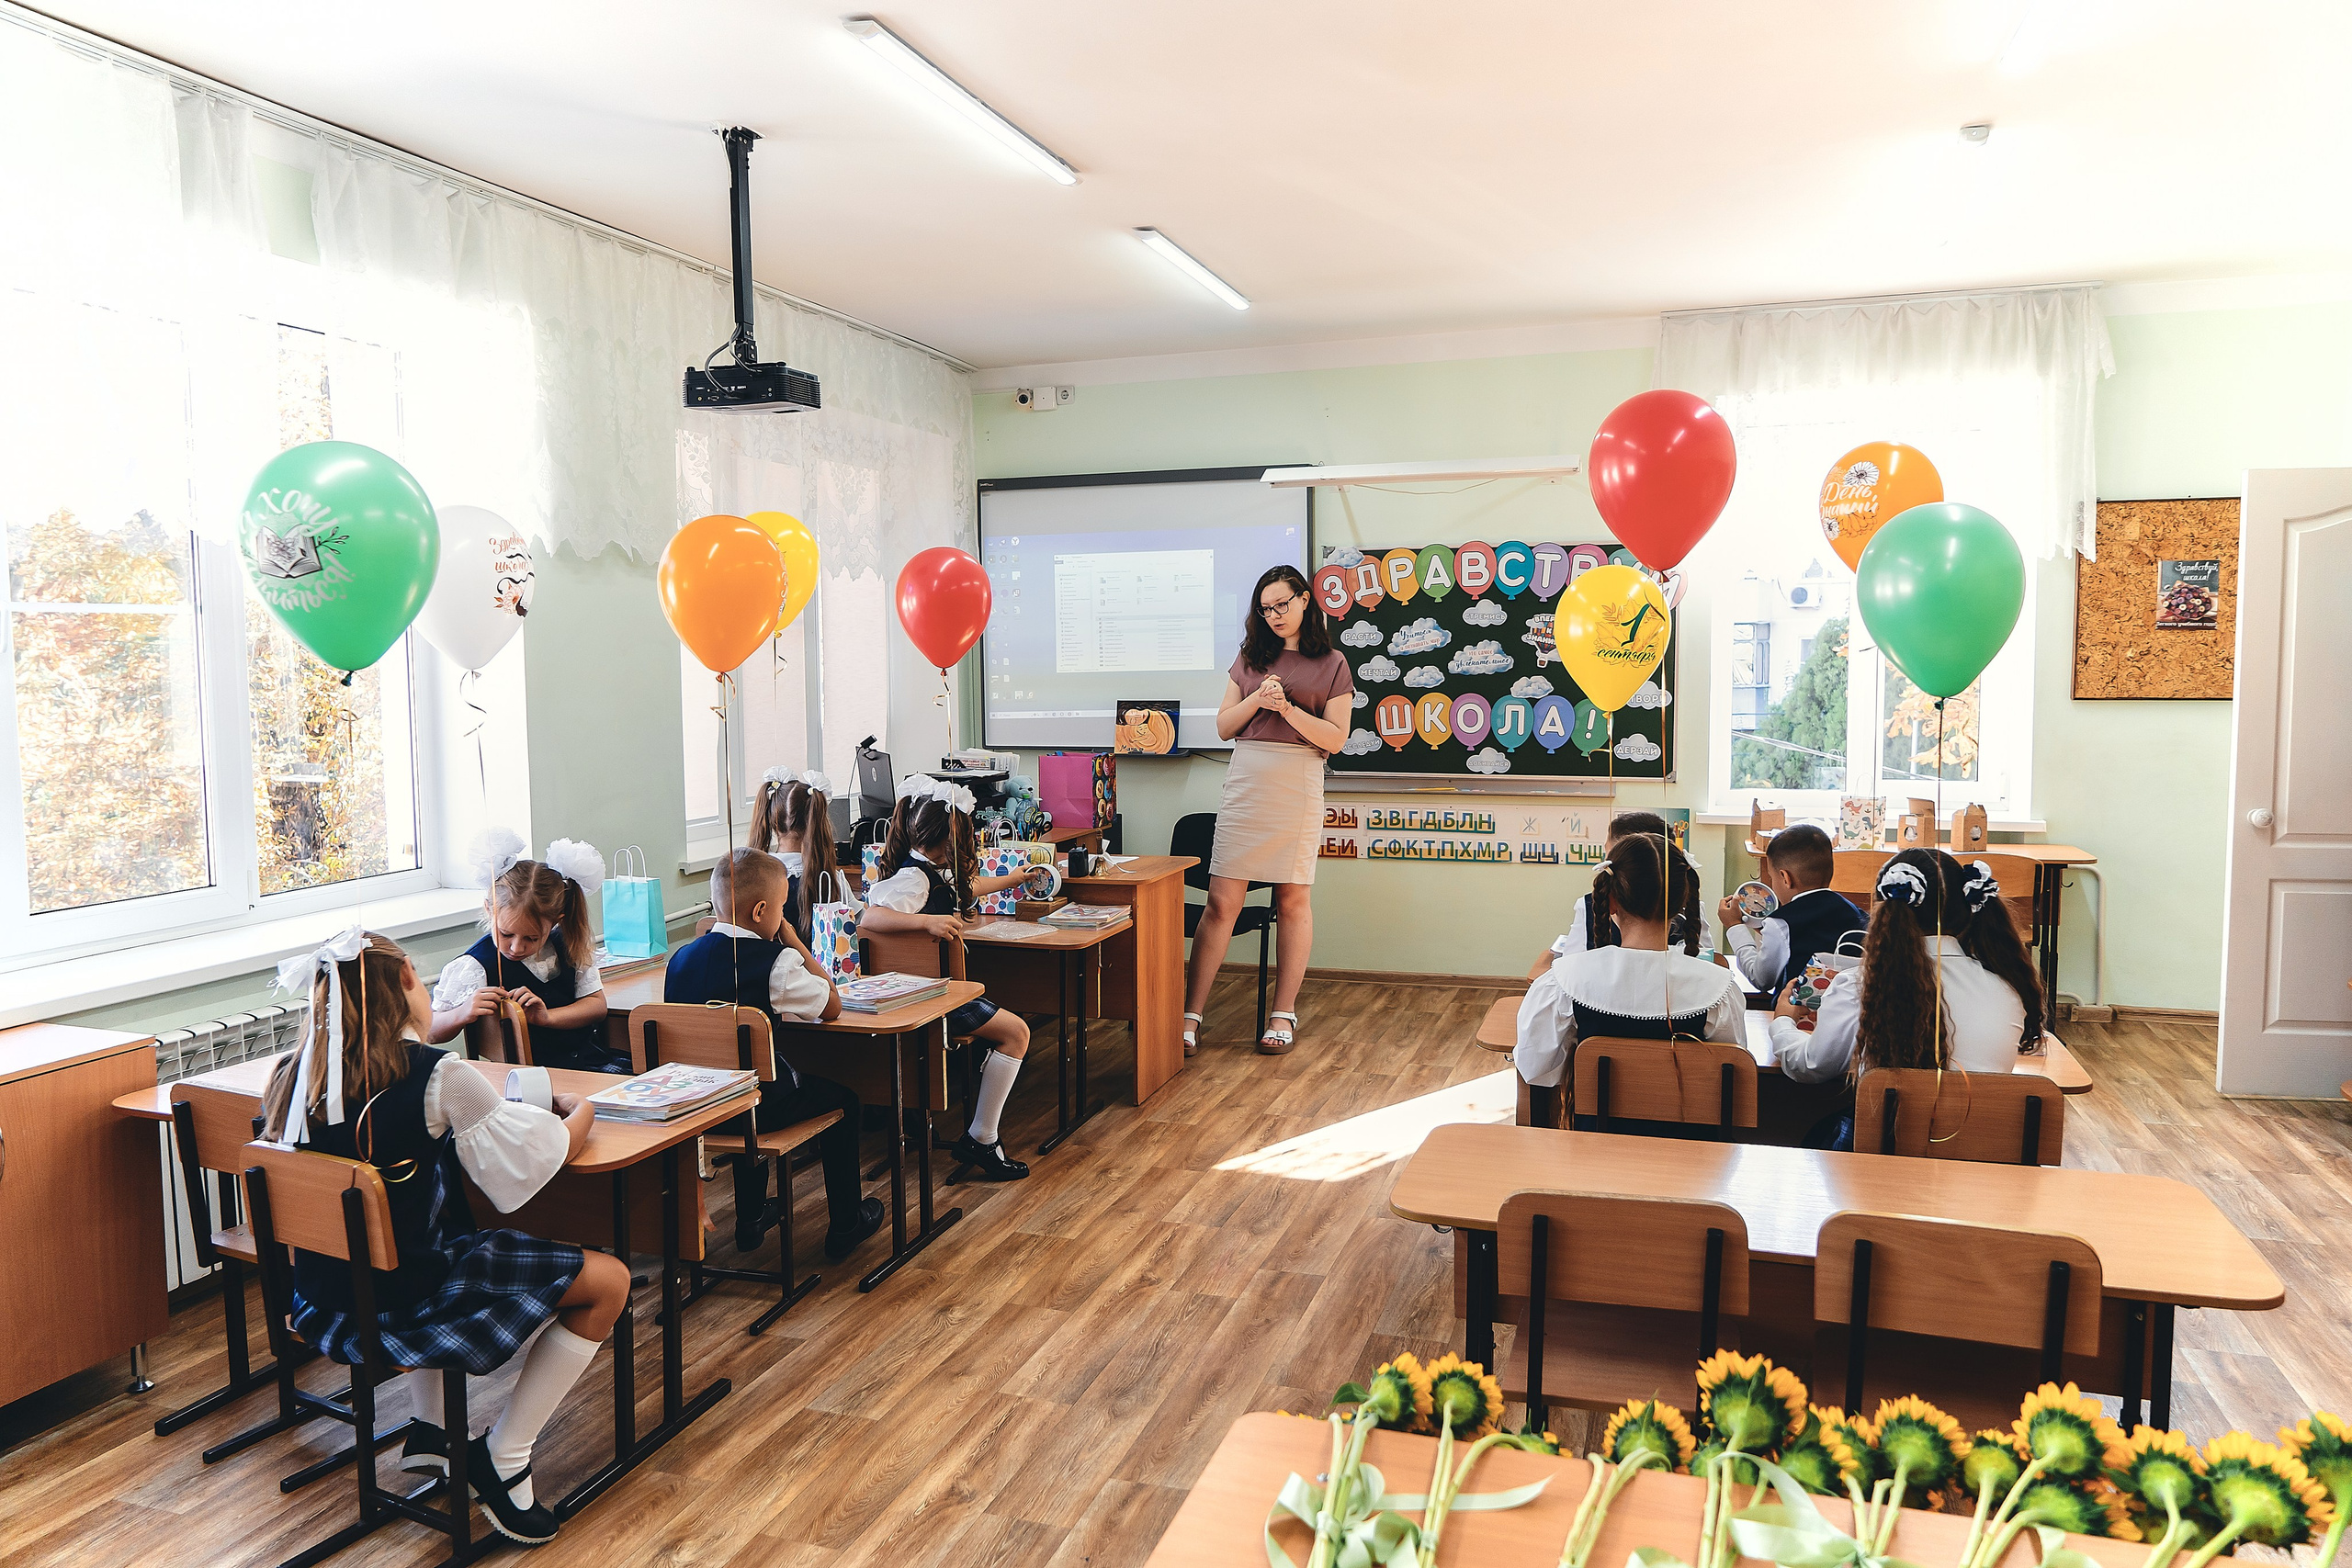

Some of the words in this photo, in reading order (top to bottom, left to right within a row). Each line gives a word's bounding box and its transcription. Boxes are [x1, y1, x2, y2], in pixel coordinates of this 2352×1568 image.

[1824, 482, 1872, 502] День
[1464, 613, 1506, 621] СТРЕМИСЬ
[1621, 604, 1651, 647] 1
[1345, 632, 1377, 641] РАСТИ
[1361, 667, 1397, 677] МЕЧТАЙ
[1617, 745, 1658, 755] ДЕРЗАЙ
